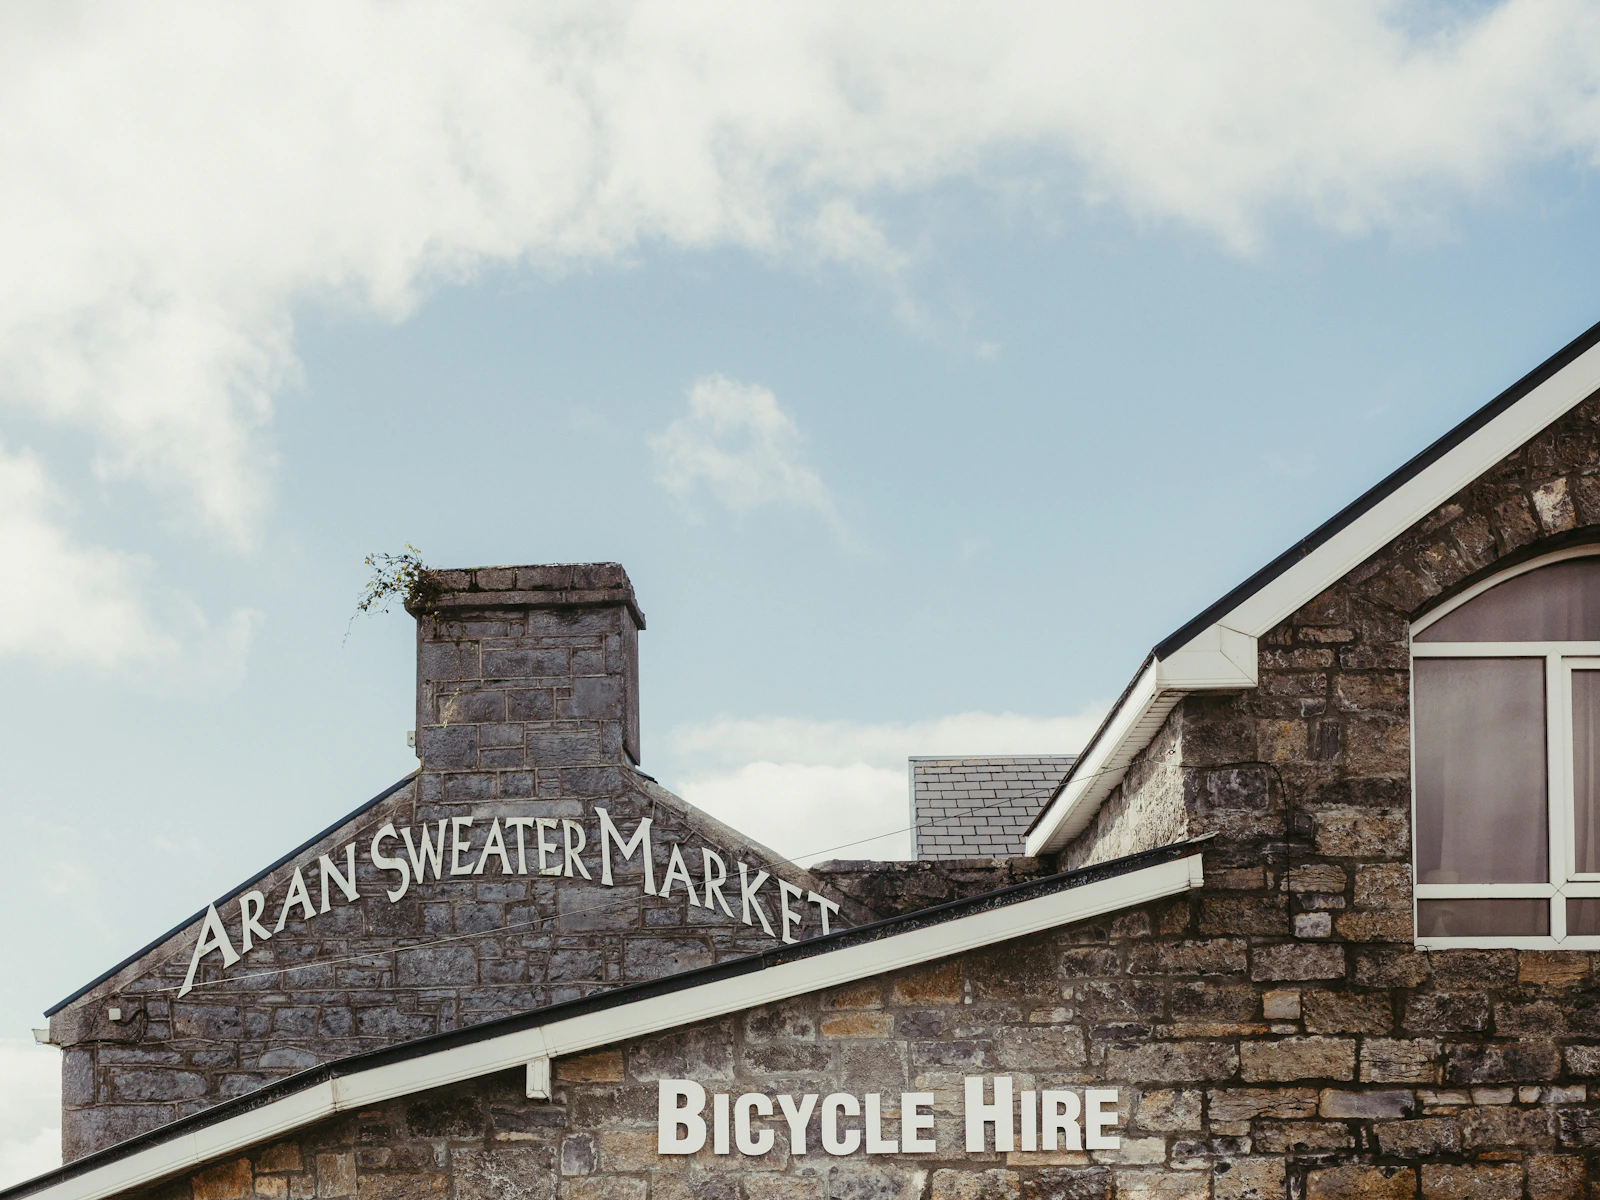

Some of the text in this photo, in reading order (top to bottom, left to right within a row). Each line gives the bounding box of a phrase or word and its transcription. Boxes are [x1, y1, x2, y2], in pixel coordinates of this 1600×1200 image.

[177, 807, 840, 999] ARAN SWEATER MARKET
[658, 1076, 1121, 1156] BICYCLE HIRE
